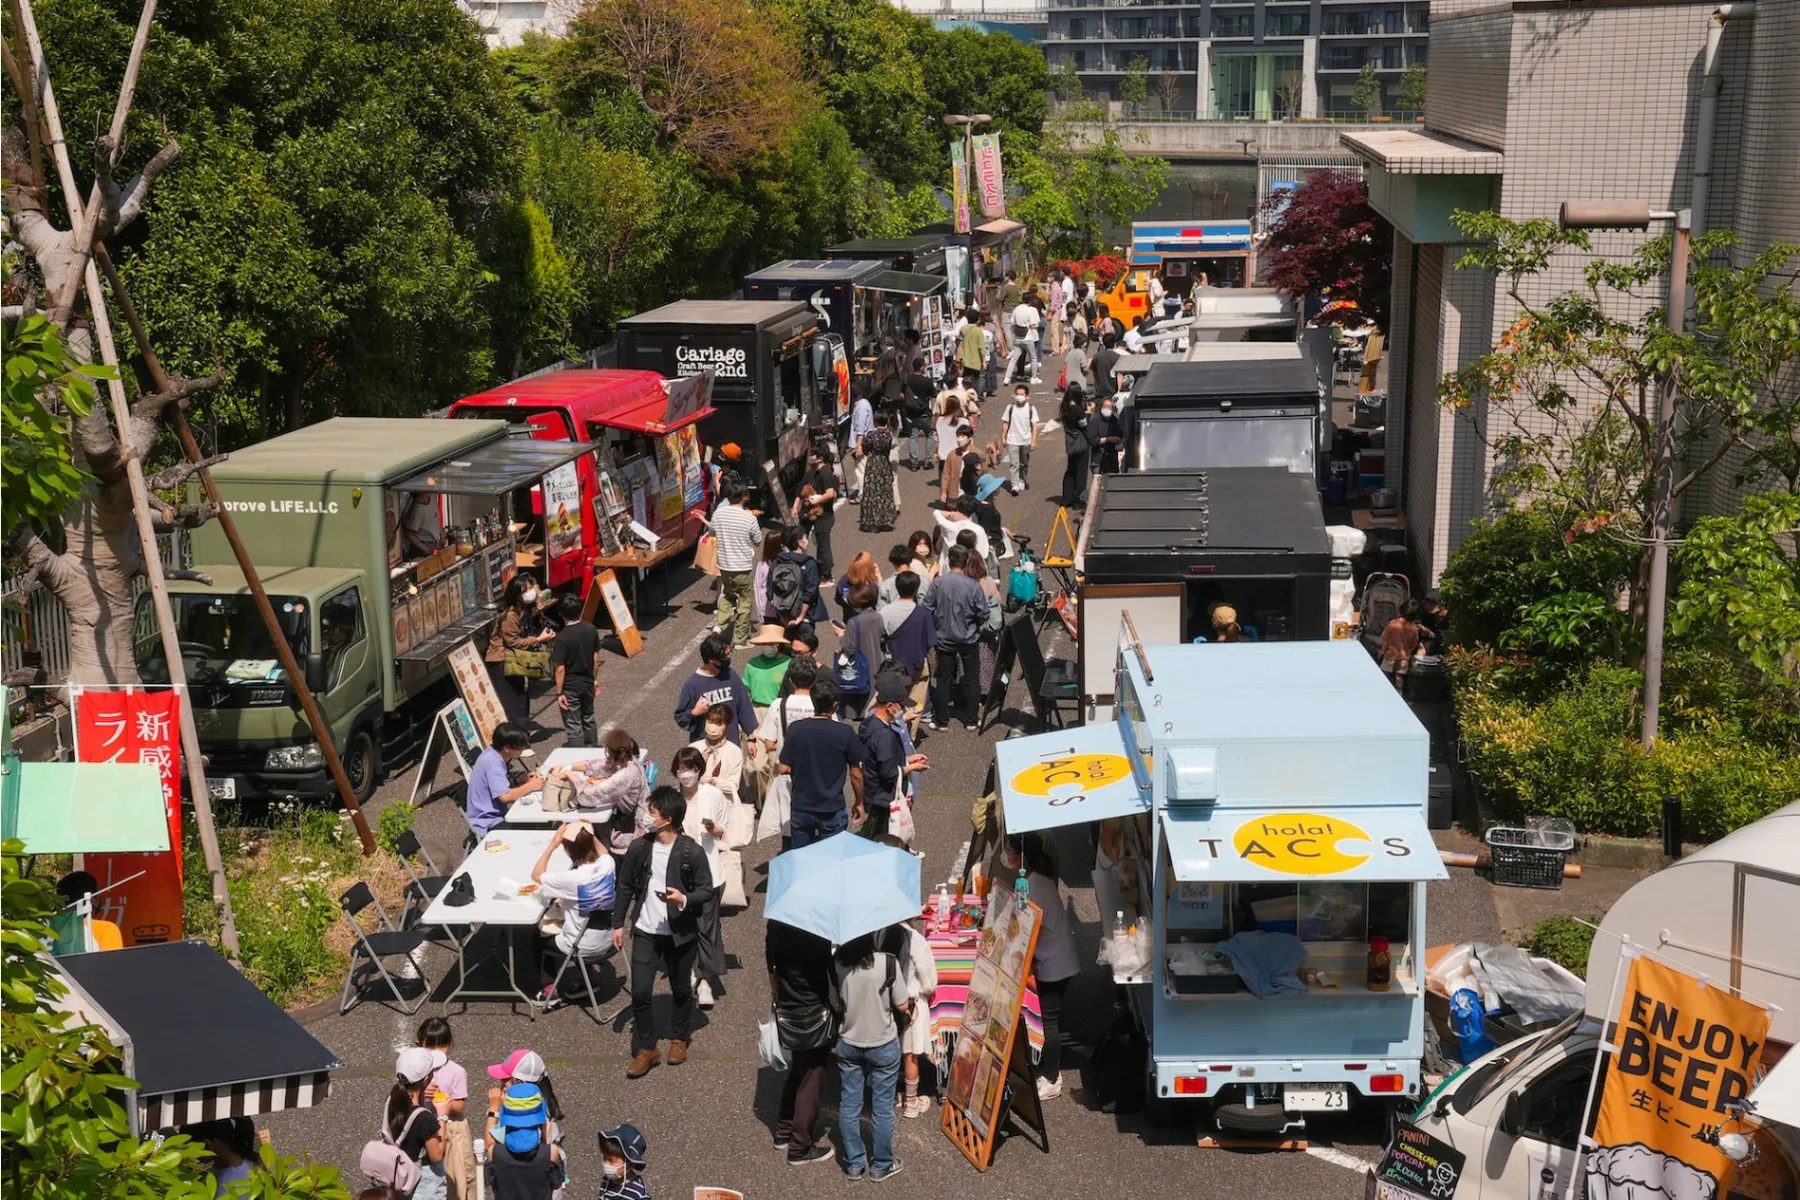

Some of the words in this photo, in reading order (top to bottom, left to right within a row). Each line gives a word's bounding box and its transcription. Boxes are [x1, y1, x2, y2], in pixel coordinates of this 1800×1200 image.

[676, 346, 746, 364] Cariage
[715, 363, 747, 377] 2nd
[703, 686, 734, 706] YALE
[1263, 823, 1334, 836] hola!
[1629, 990, 1759, 1072] ENJOY
[1325, 1092, 1343, 1107] 23
[1398, 1129, 1430, 1146] PANINI
[1391, 1149, 1425, 1170] POPCORN
[1393, 1160, 1425, 1186] ALCOHOL
